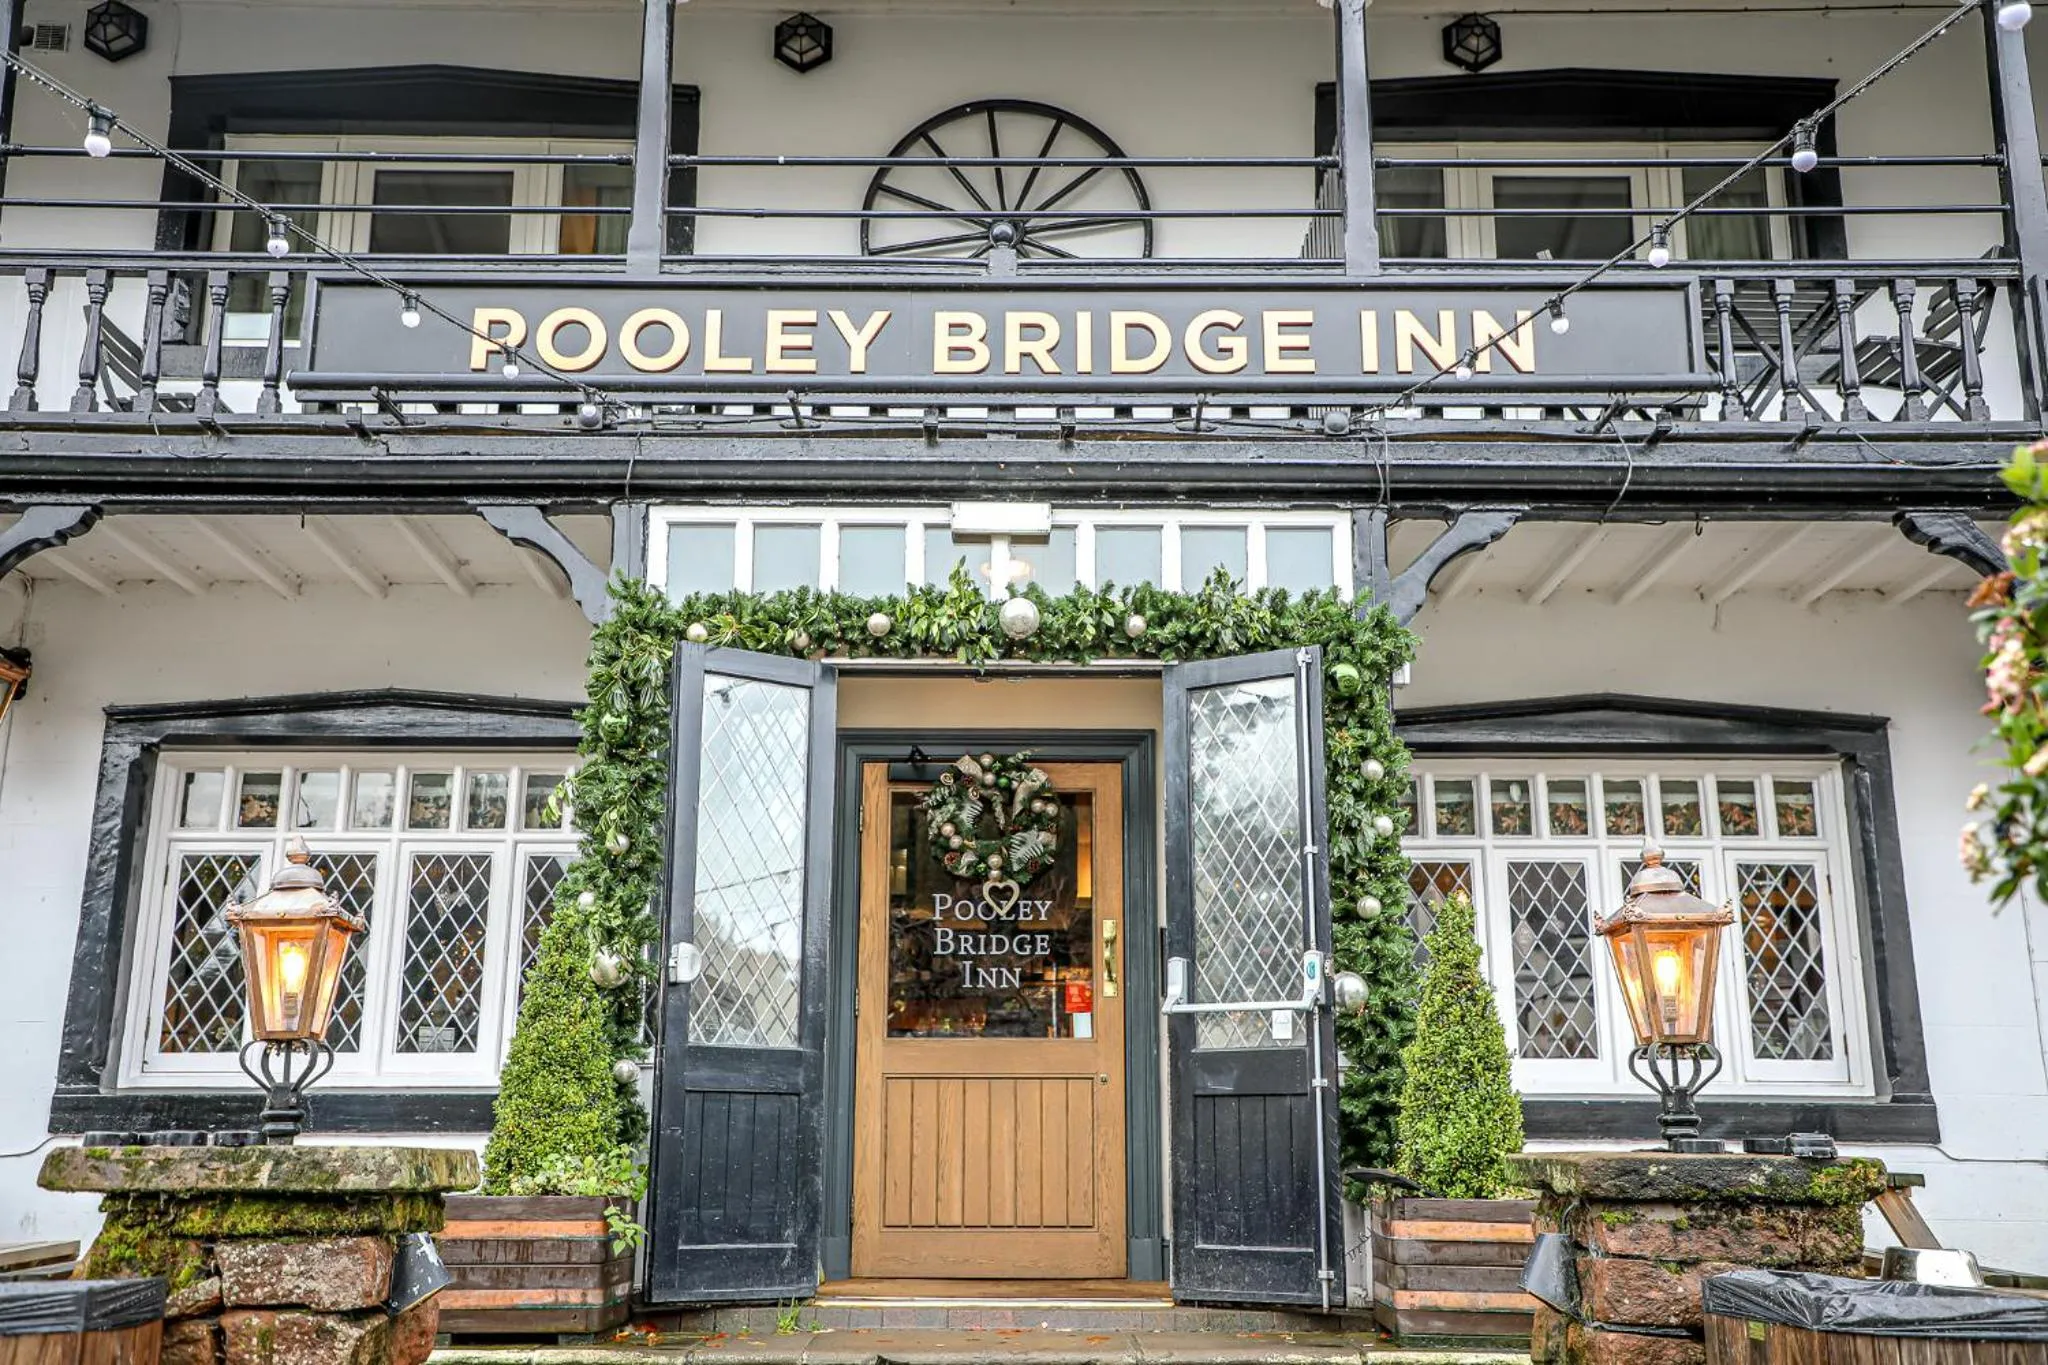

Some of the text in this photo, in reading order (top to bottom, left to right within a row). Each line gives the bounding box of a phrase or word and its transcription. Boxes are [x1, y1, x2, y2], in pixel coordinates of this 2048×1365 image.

[470, 307, 1536, 375] POOLEY BRIDGE INN
[933, 927, 1051, 955] BRIDGE
[962, 961, 1021, 988] INN
